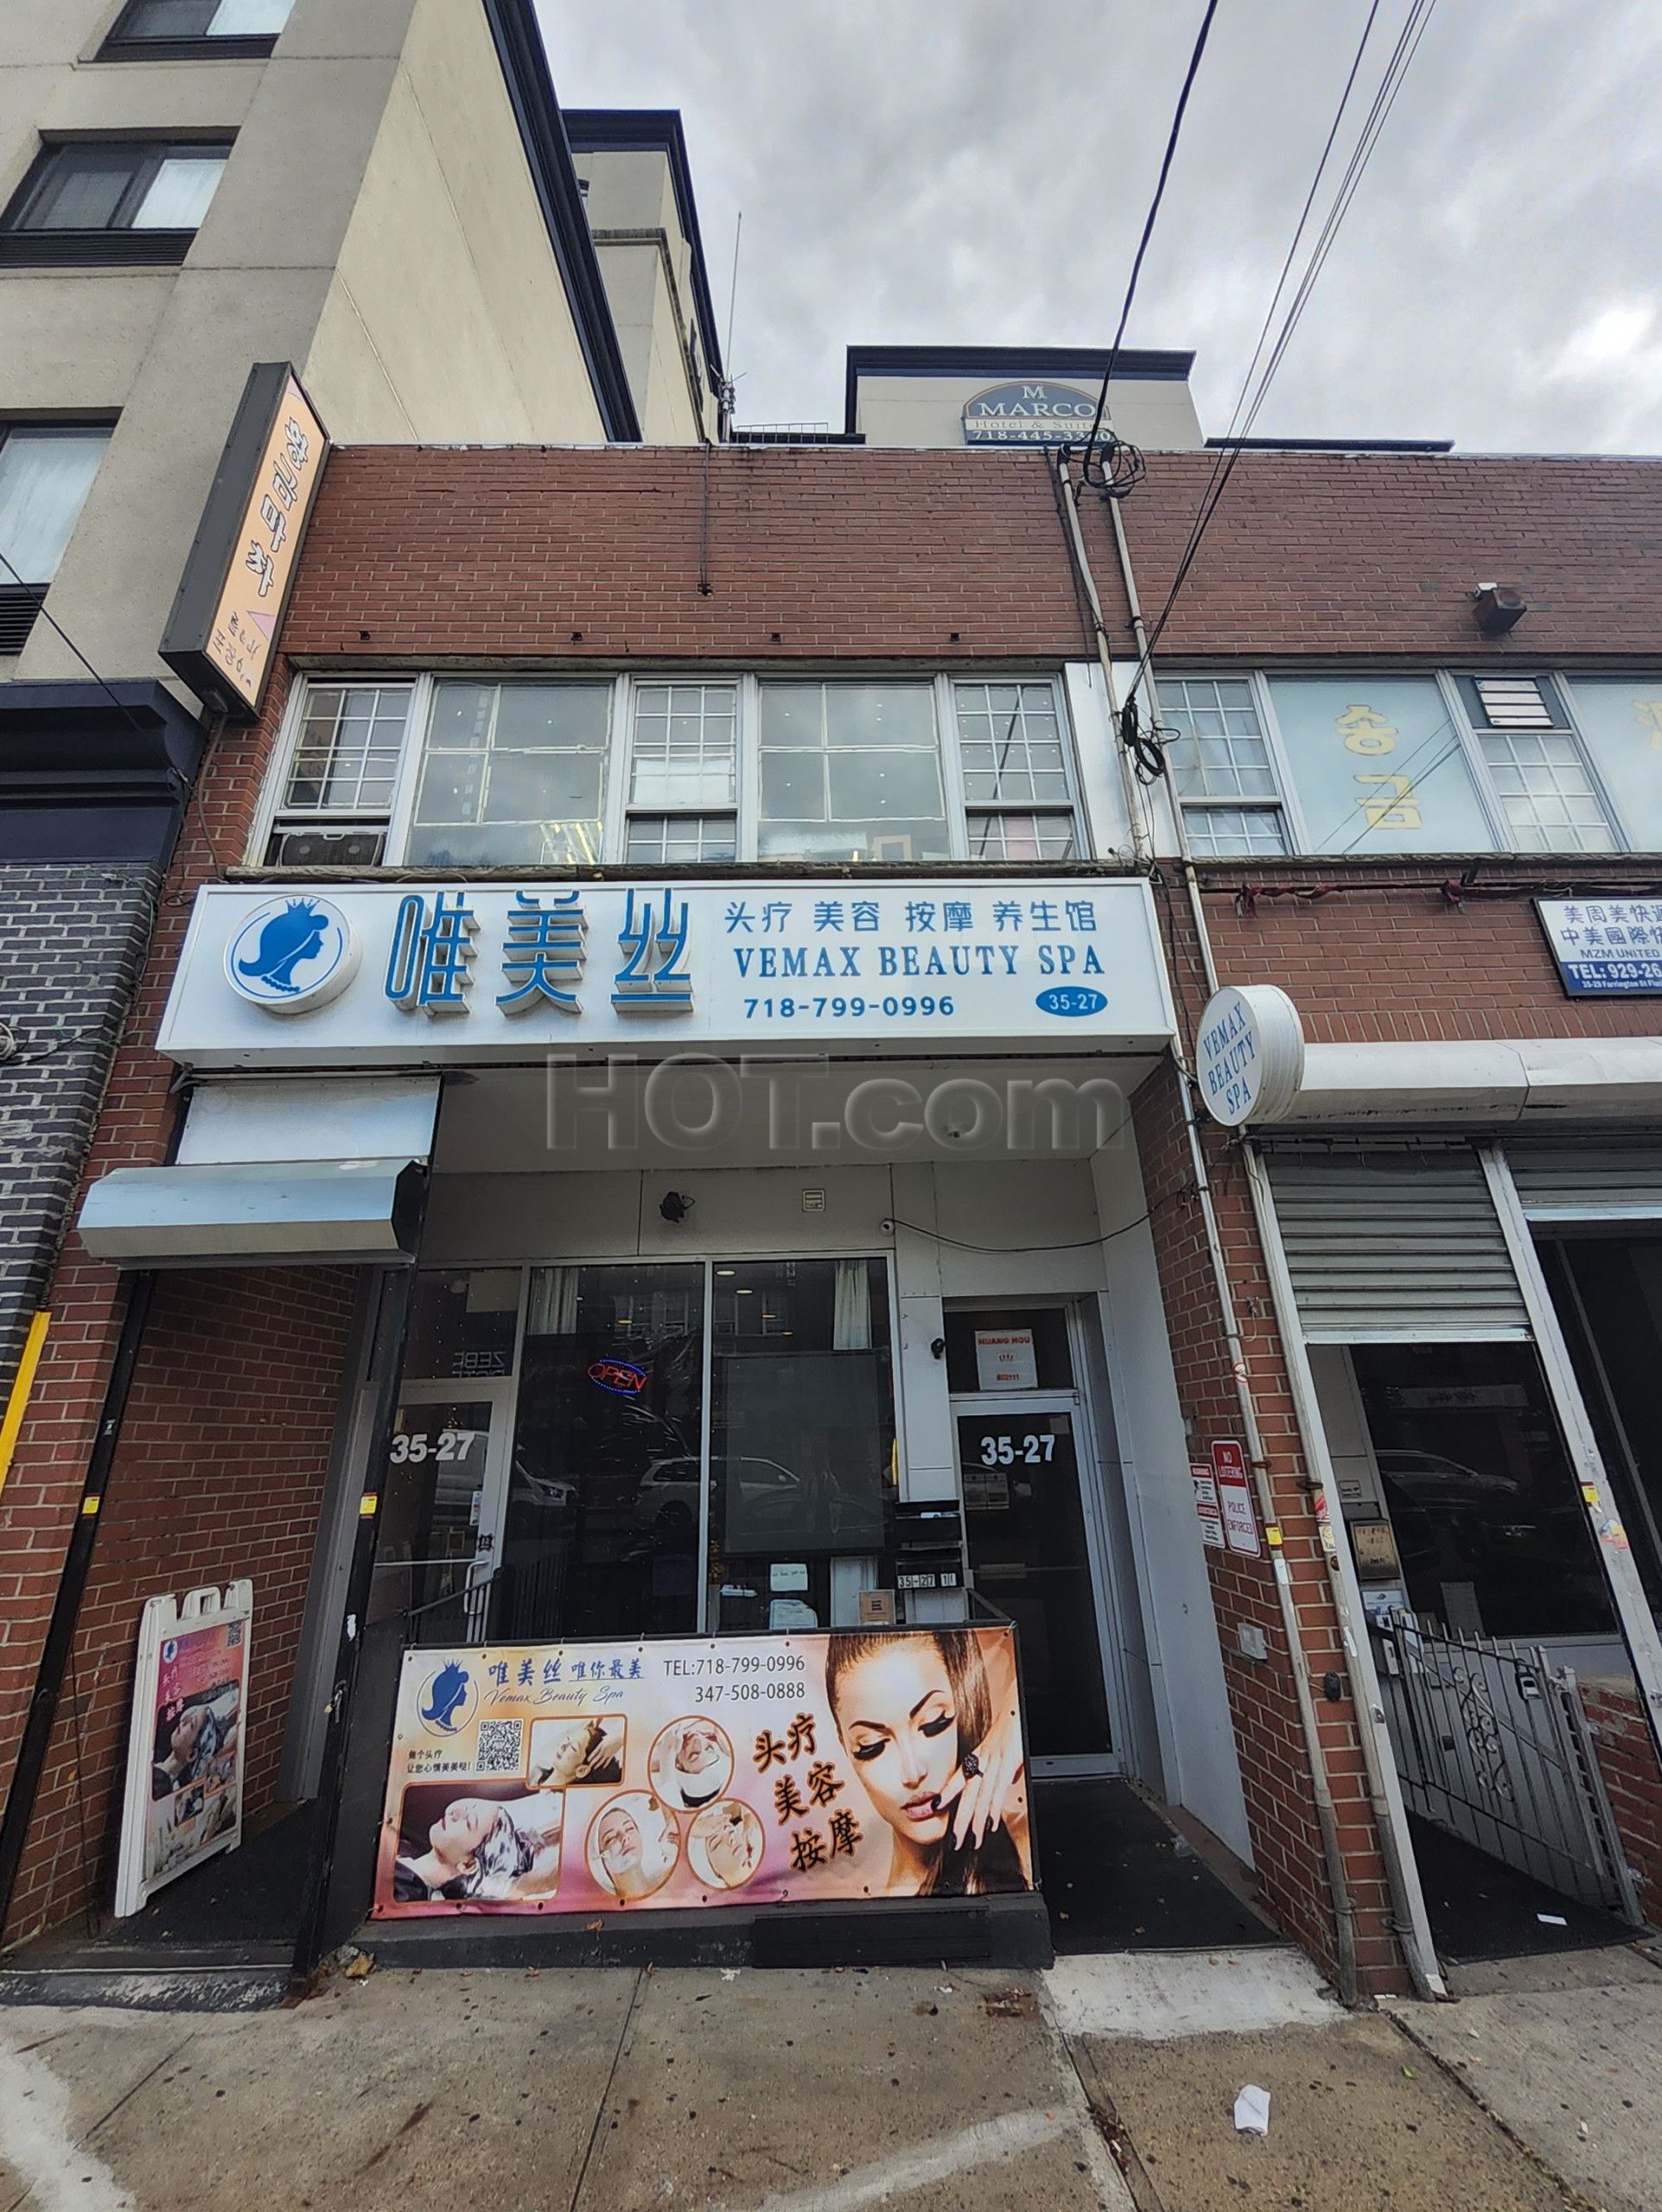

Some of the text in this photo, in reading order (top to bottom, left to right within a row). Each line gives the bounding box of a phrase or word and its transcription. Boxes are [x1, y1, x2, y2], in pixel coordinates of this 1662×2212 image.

[1022, 386, 1047, 398] M
[978, 403, 1095, 416] MARCO
[245, 416, 308, 597] 황금마차
[724, 900, 1097, 933] 头疗 美容 按摩 养生馆
[384, 888, 694, 1014] 唯美丝
[734, 944, 1105, 977] VEMAX BEAUTY SPA
[1580, 949, 1660, 958] MZM UNITED
[1568, 963, 1607, 979] TEL:
[744, 996, 954, 1019] 718-799-0996
[1048, 993, 1098, 1010] 35-27
[1203, 1001, 1245, 1061] VEMAX
[1207, 1031, 1256, 1096] BEAUTY
[1226, 1076, 1251, 1116] SPA
[588, 1363, 647, 1390] OPEN
[389, 1433, 475, 1464] 35-27
[981, 1434, 1055, 1465] 35-27
[1226, 1500, 1246, 1515] POLICE
[899, 1575, 933, 1588] 35-27
[488, 1658, 642, 1686] 唯美丝 唯你最美
[664, 1655, 805, 1676] TEL:718-799-0996
[484, 1685, 624, 1707] Vemax Beauty Spa
[695, 1681, 805, 1703] 347-508-0888
[753, 1713, 816, 1773] 头疗
[774, 1761, 844, 1826] 美容
[790, 1808, 863, 1872] 按摩
